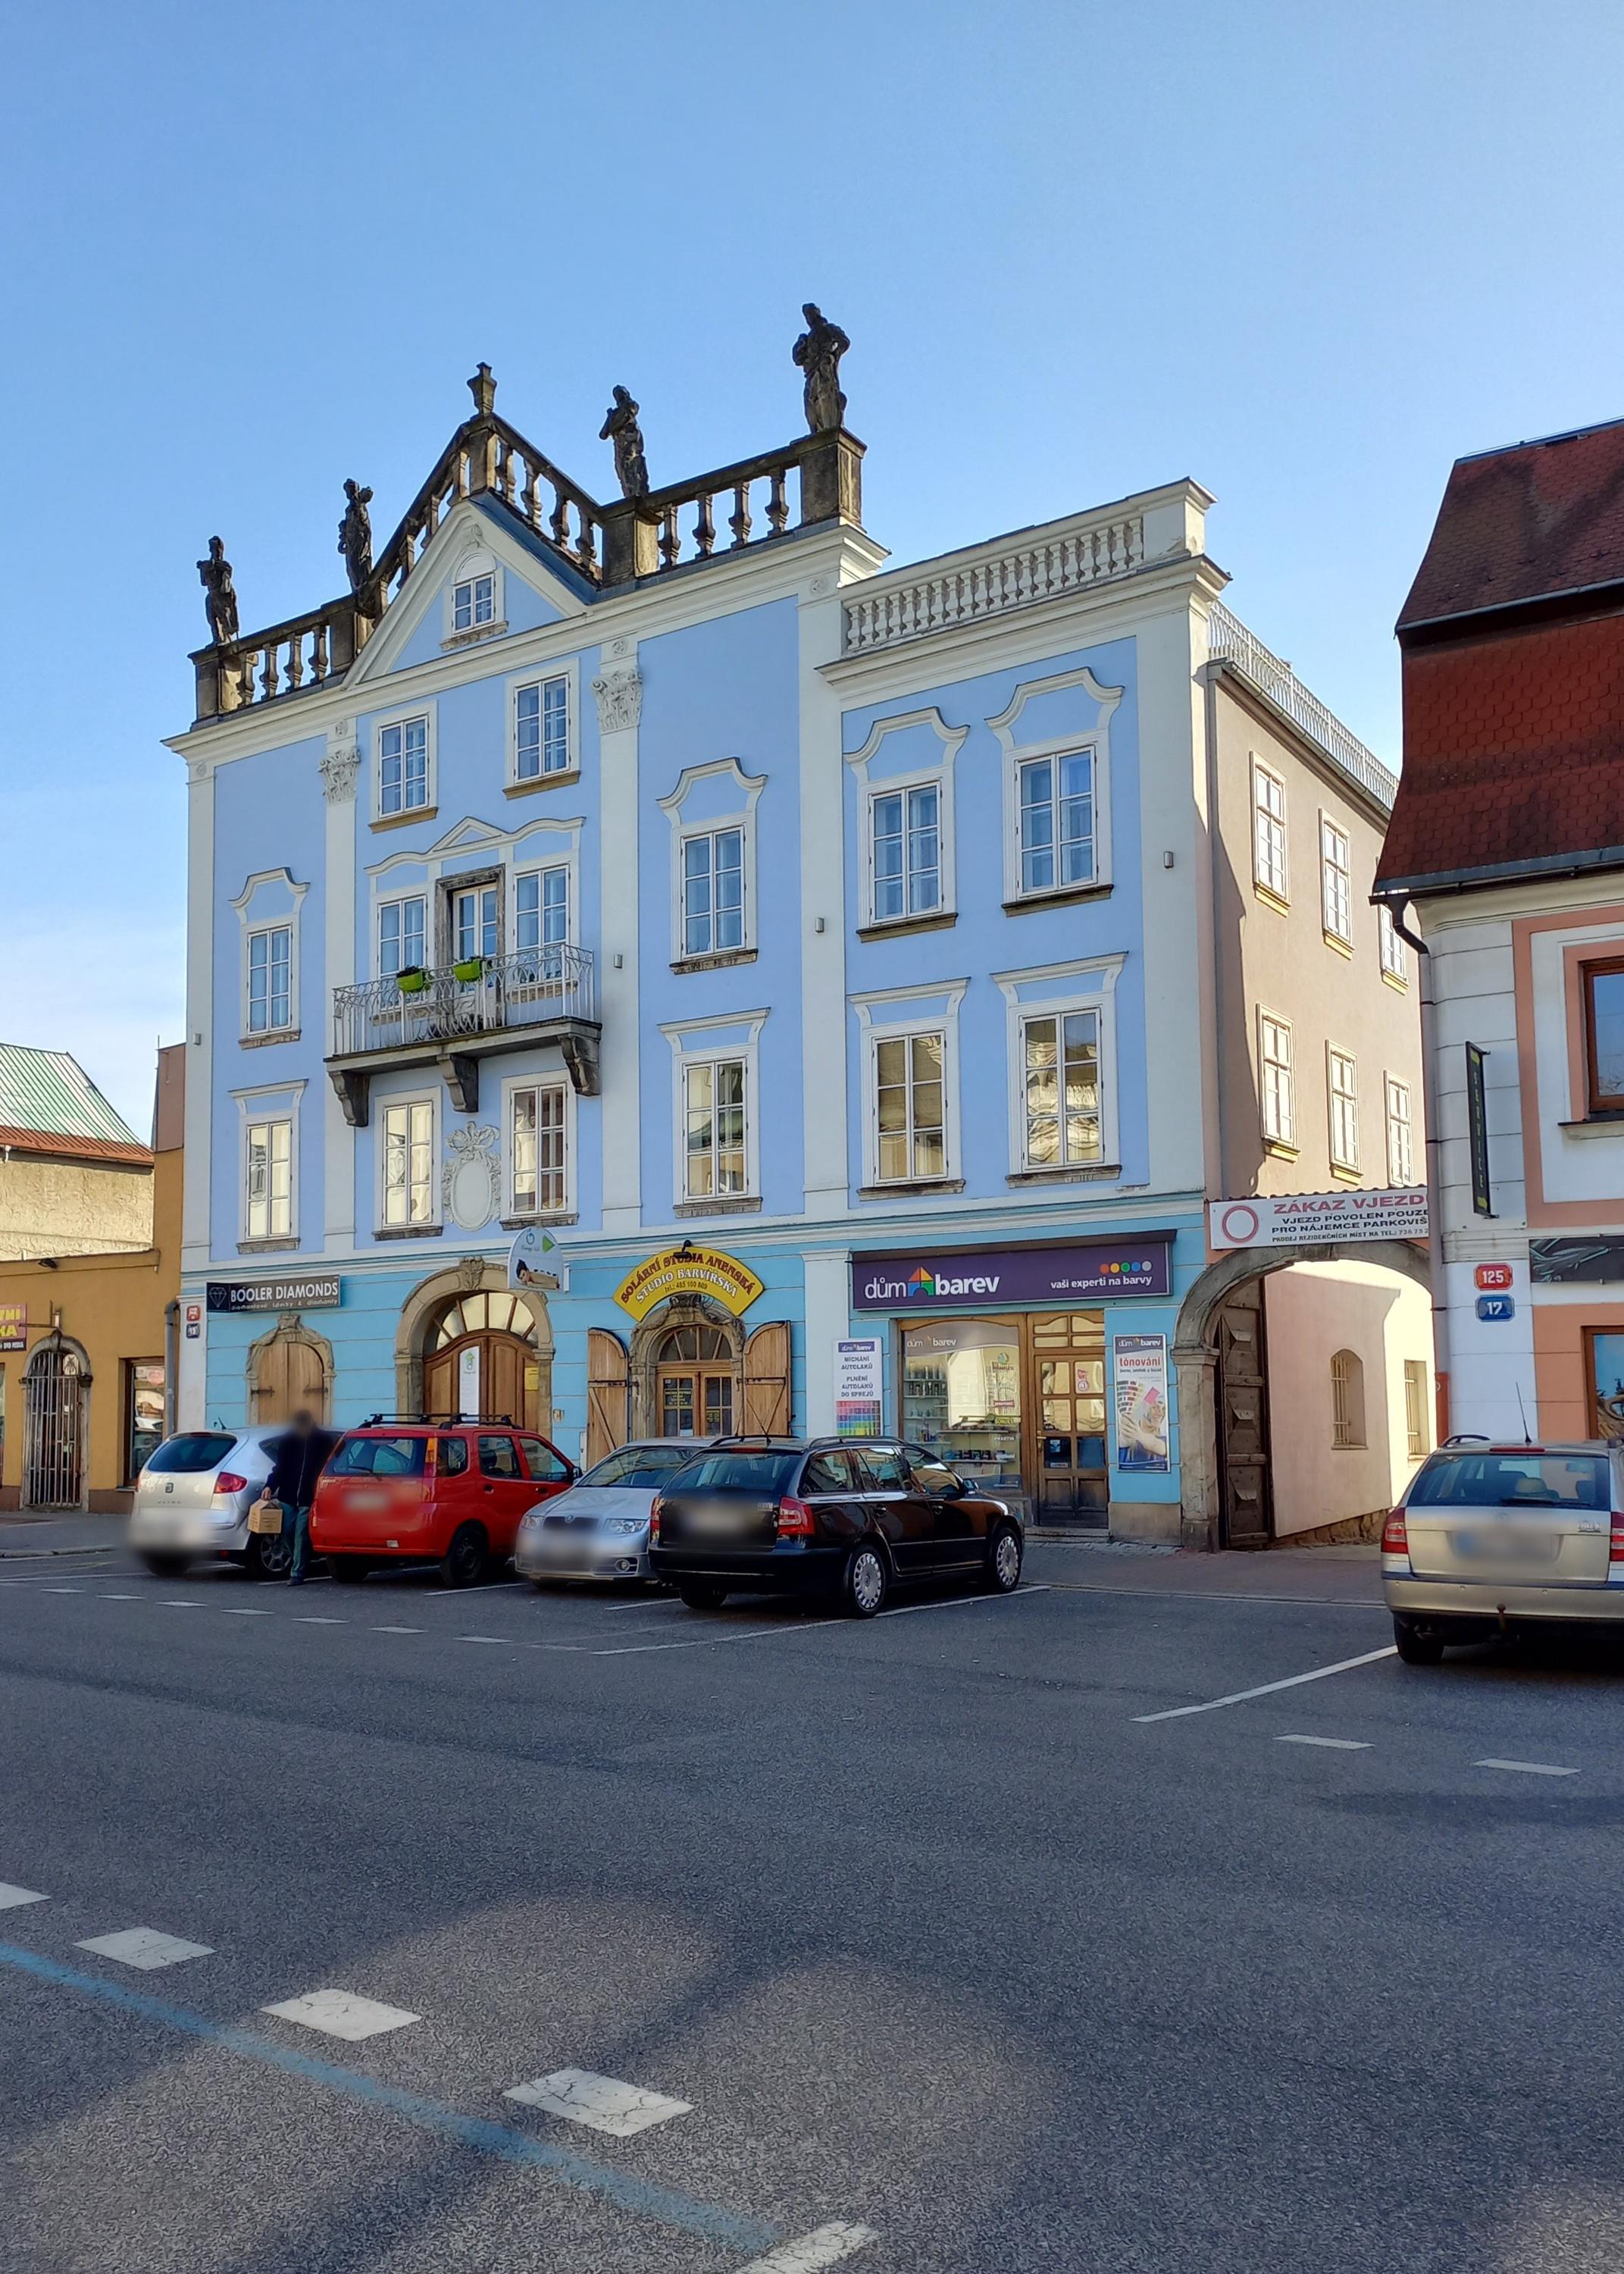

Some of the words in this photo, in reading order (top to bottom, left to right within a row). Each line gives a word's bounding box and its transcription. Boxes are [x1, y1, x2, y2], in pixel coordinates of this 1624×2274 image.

[1274, 1199, 1346, 1214] ZÁKAZ
[1352, 1195, 1428, 1209] VJEZD
[1282, 1217, 1322, 1225] VJEZD
[1325, 1213, 1384, 1223] POVOLEN
[1300, 1222, 1360, 1232] NÁJEMCE
[1363, 1216, 1428, 1228] PARKOVIŠ
[1050, 1279, 1069, 1289] vaši
[1071, 1276, 1106, 1289] experti
[1122, 1276, 1153, 1286] barvy
[1482, 1270, 1504, 1284] 125
[230, 1287, 273, 1303] BOOLER
[275, 1282, 339, 1299] DIAMONDS
[636, 1270, 674, 1304] STUDIO
[865, 1276, 906, 1299] dům
[935, 1273, 1000, 1295] barev
[1486, 1301, 1502, 1315] 17
[933, 1338, 956, 1346] barev
[1119, 1357, 1161, 1367] tónování
